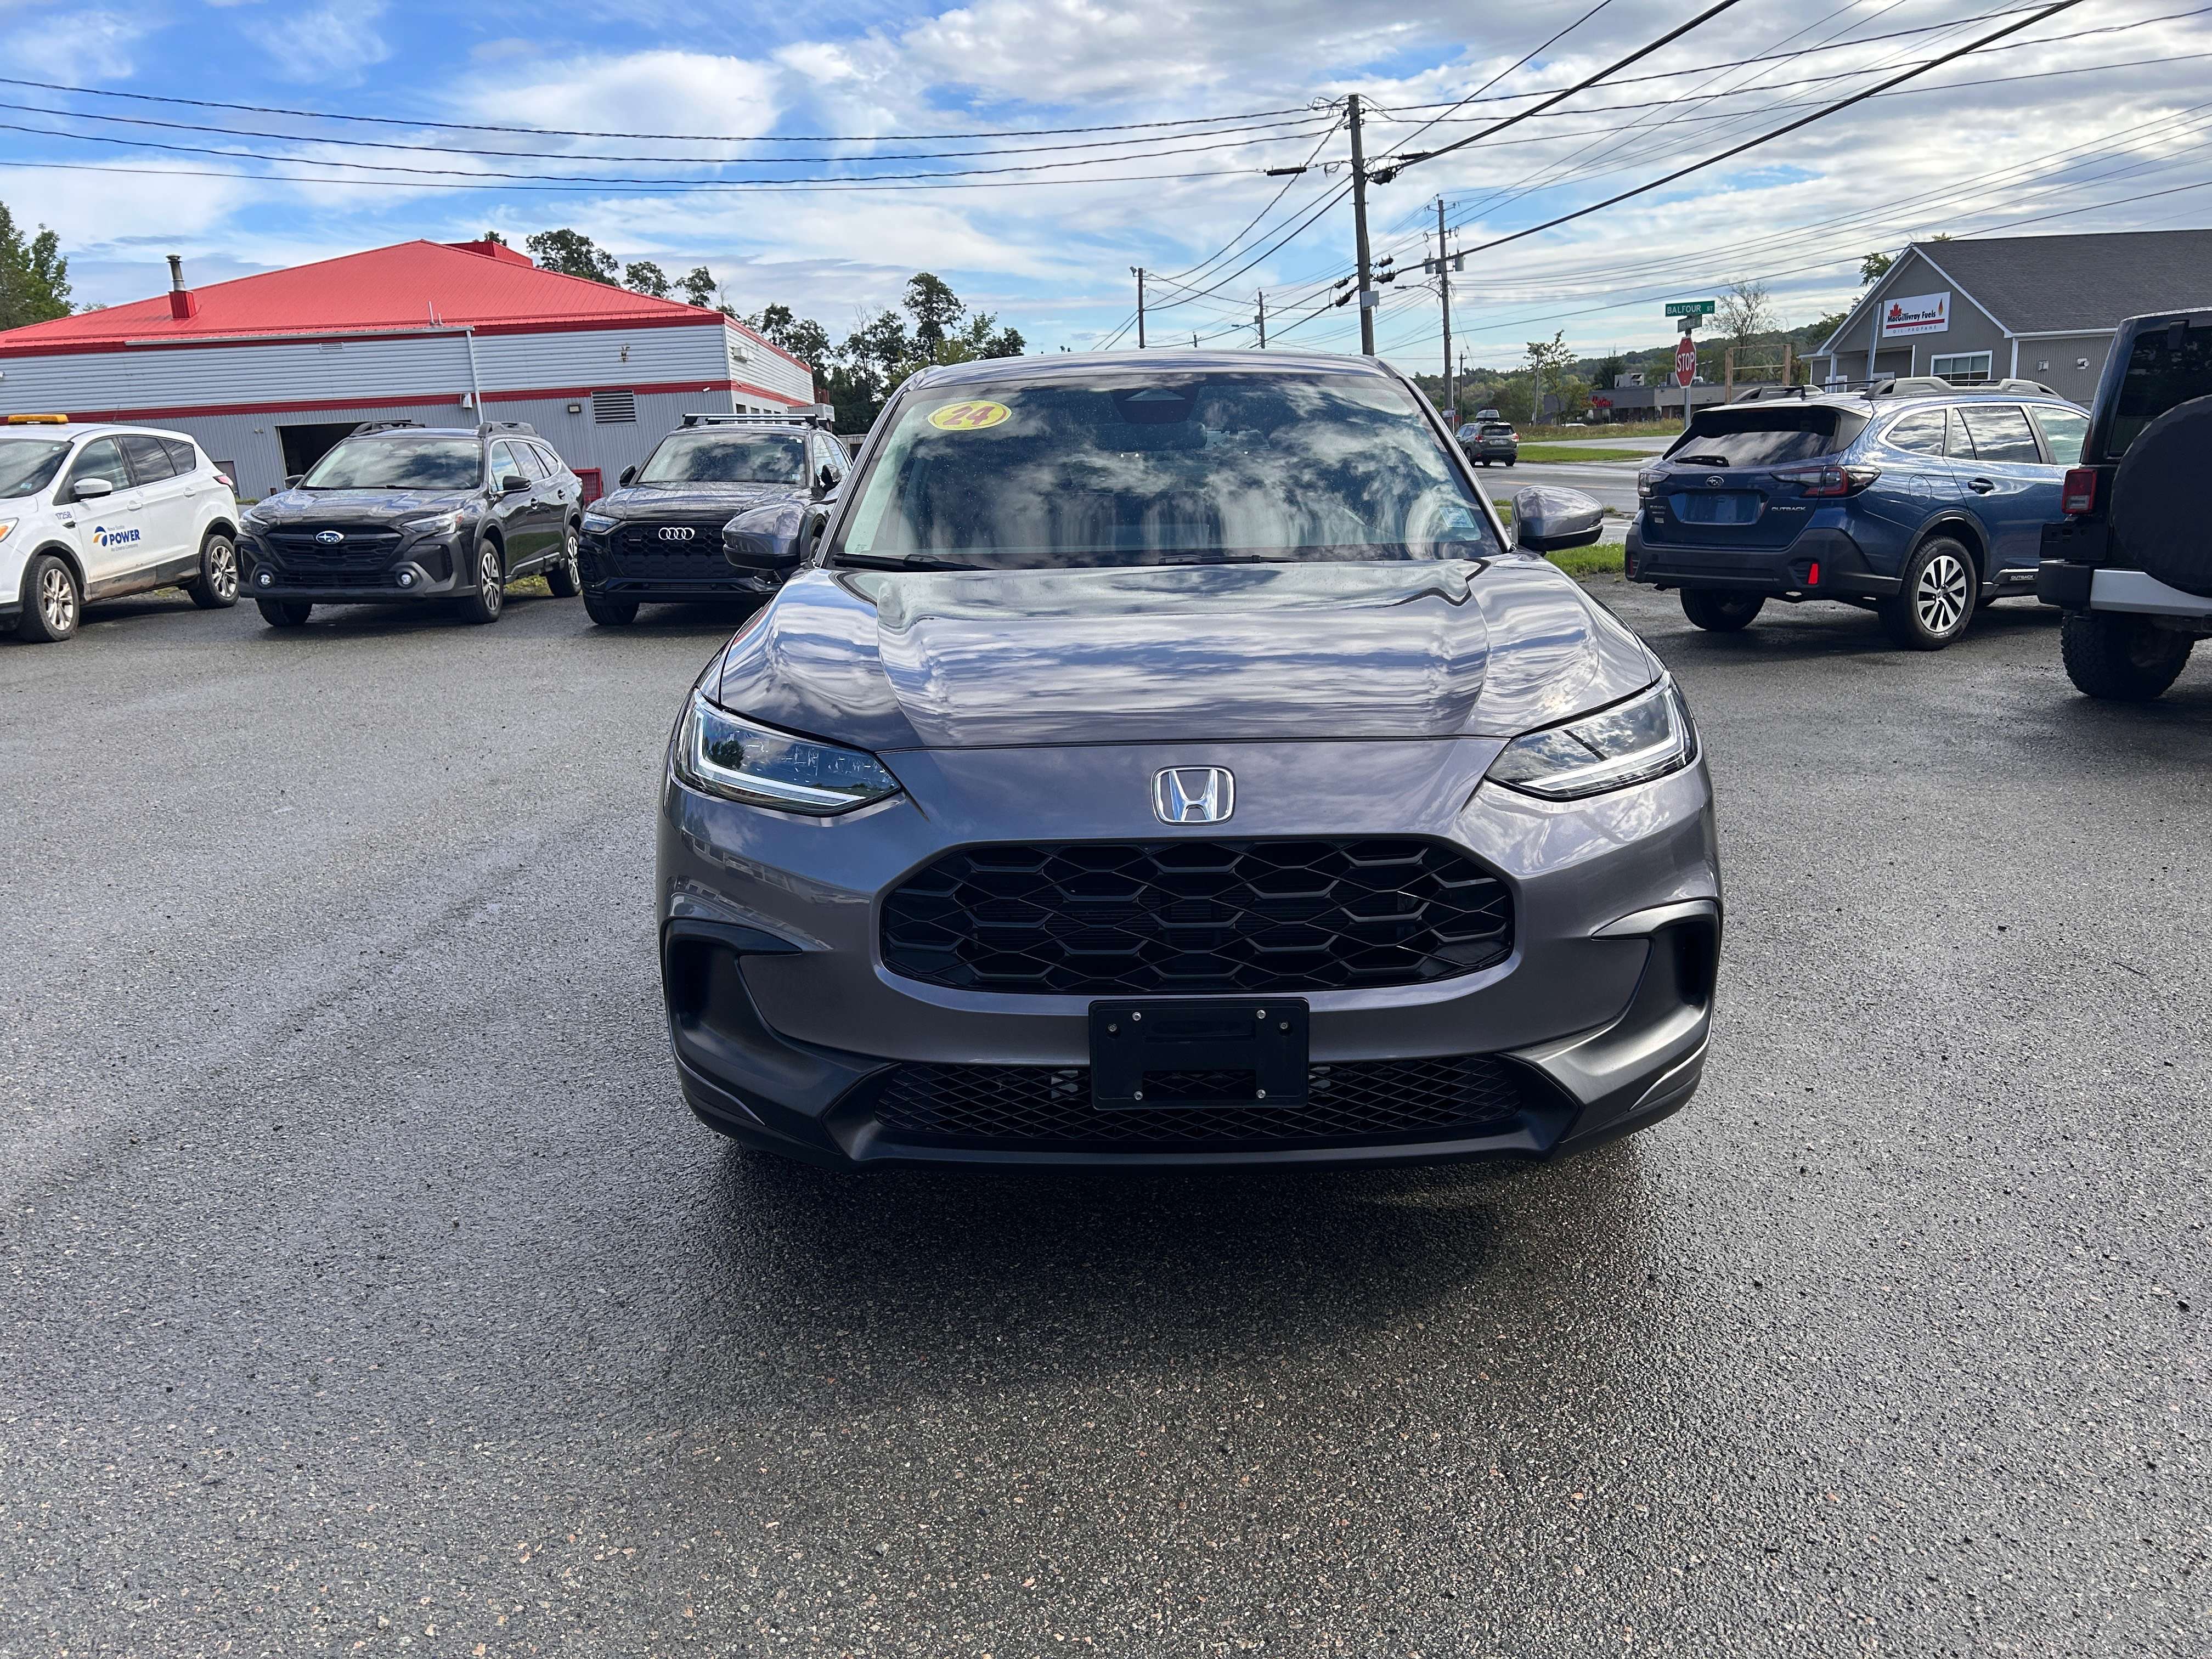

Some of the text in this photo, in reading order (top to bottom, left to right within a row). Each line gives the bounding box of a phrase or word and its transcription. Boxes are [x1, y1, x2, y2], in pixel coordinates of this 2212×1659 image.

[1667, 304, 1701, 314] BALFOUR
[1887, 309, 1936, 323] MacGillivray Fuels
[1677, 351, 1695, 373] STOP
[943, 405, 995, 425] 24
[110, 529, 140, 545] POWER
